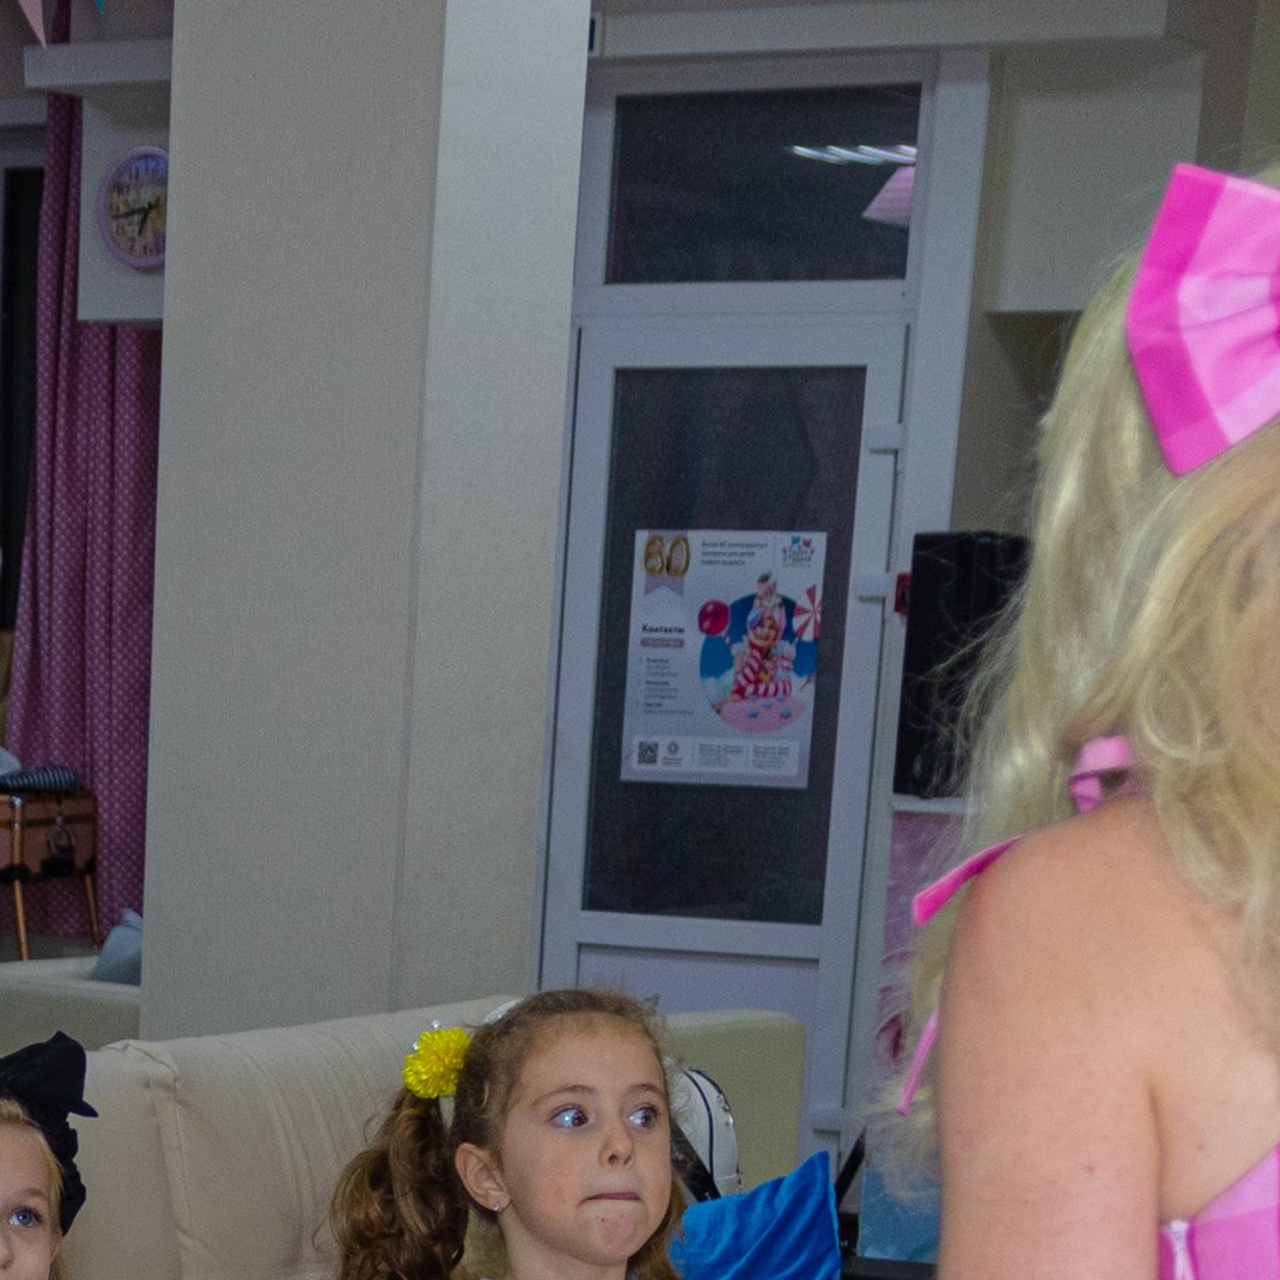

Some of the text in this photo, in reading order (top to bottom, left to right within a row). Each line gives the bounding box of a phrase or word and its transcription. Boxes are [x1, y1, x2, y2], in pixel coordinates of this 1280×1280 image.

[144, 158, 160, 172] 12
[115, 223, 125, 236] 8
[644, 535, 690, 577] 60
[642, 623, 685, 634] Контакты
